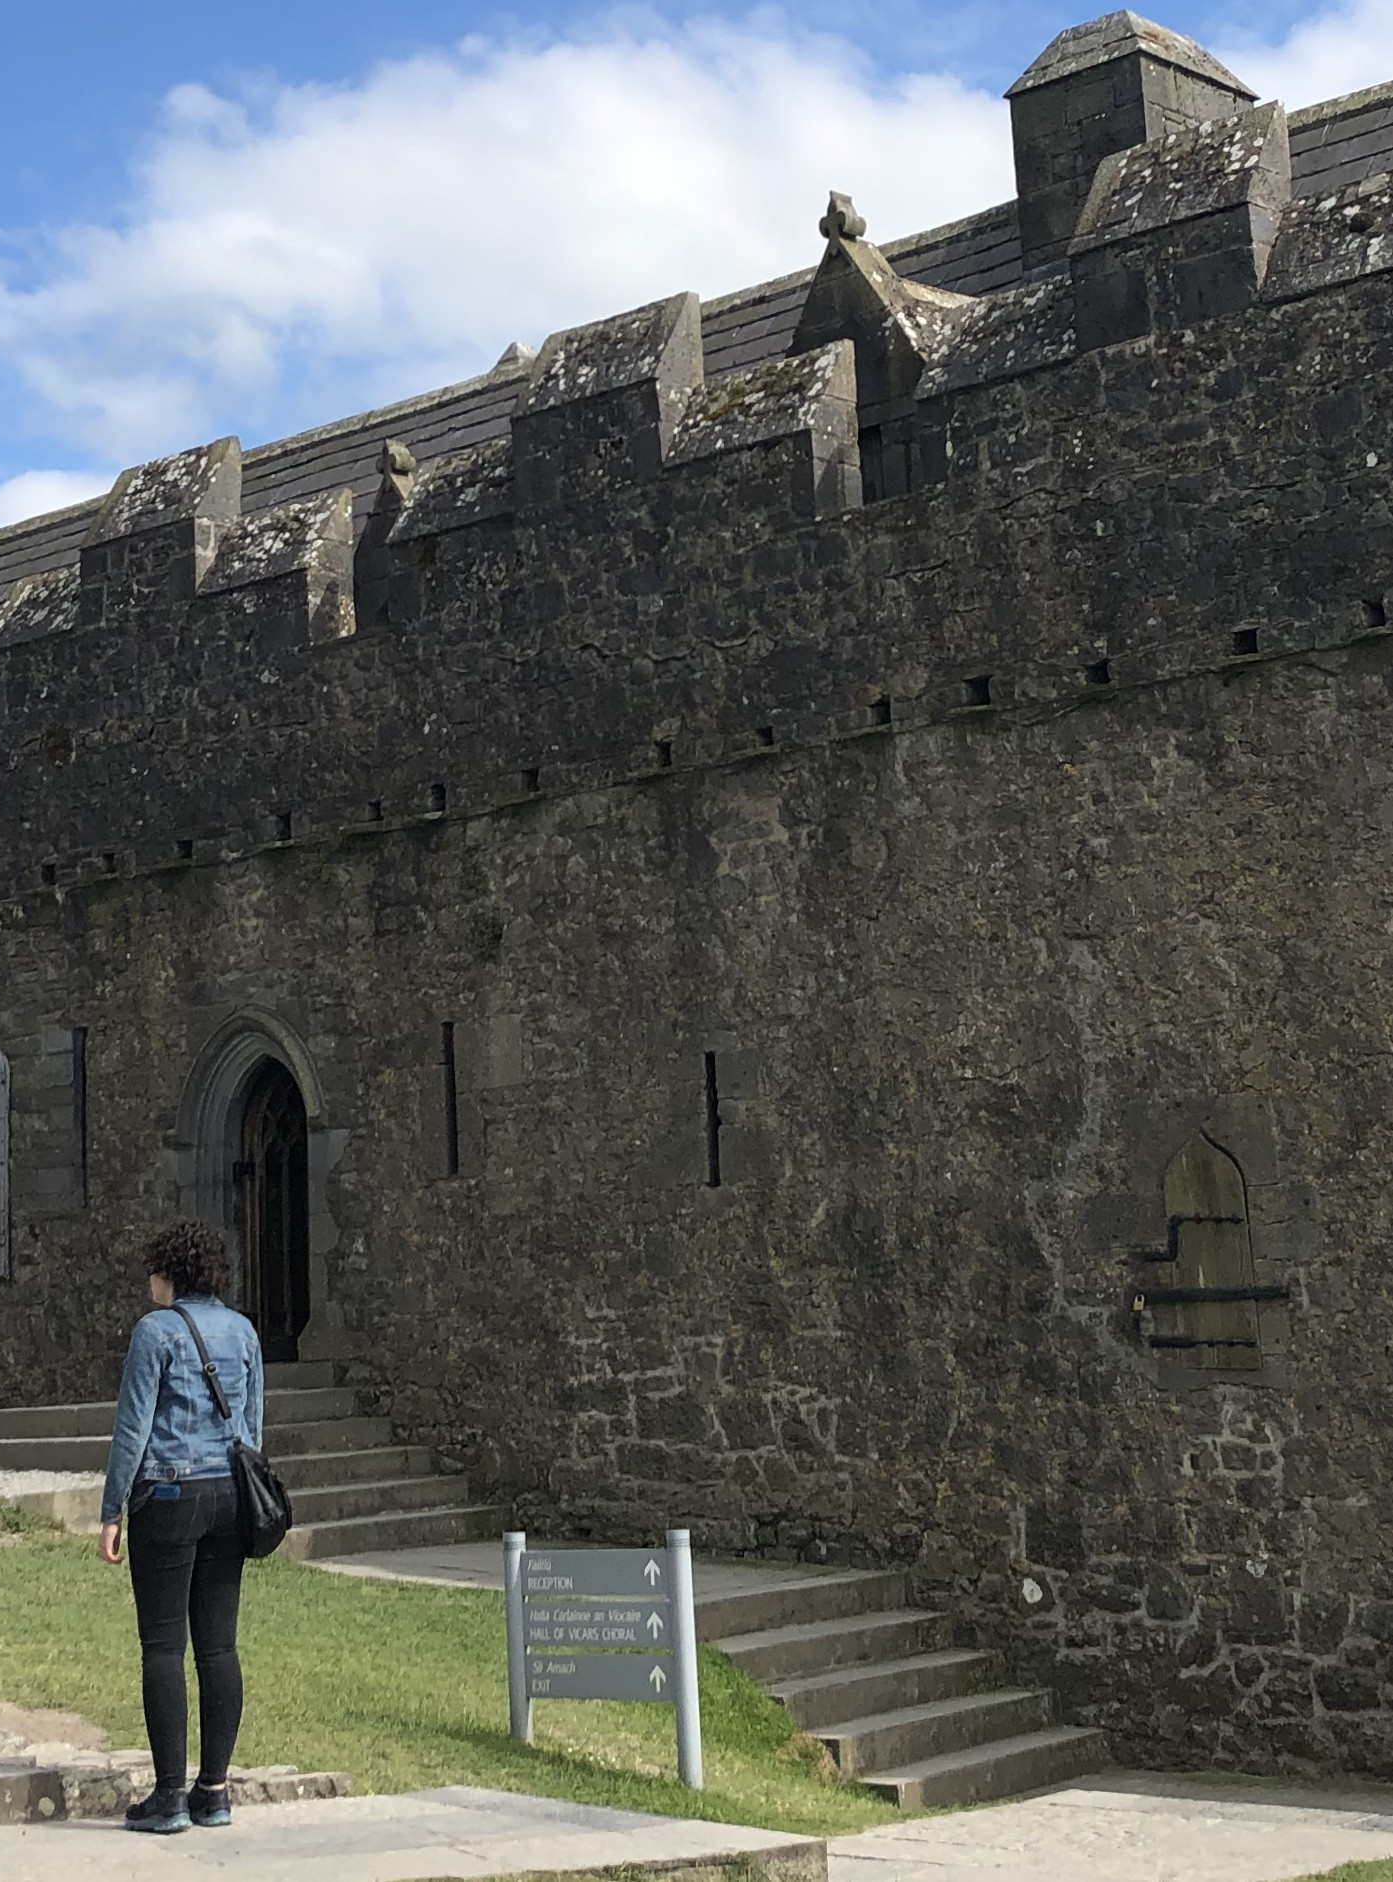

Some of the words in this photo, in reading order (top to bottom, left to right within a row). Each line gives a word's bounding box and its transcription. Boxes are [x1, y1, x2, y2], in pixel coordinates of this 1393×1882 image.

[528, 1576, 573, 1590] RECEPTION
[529, 1627, 551, 1640] HALL
[553, 1627, 565, 1640] OF
[568, 1627, 599, 1641] VICARS
[602, 1628, 637, 1642] CHORAL
[532, 1678, 551, 1692] EXIT
